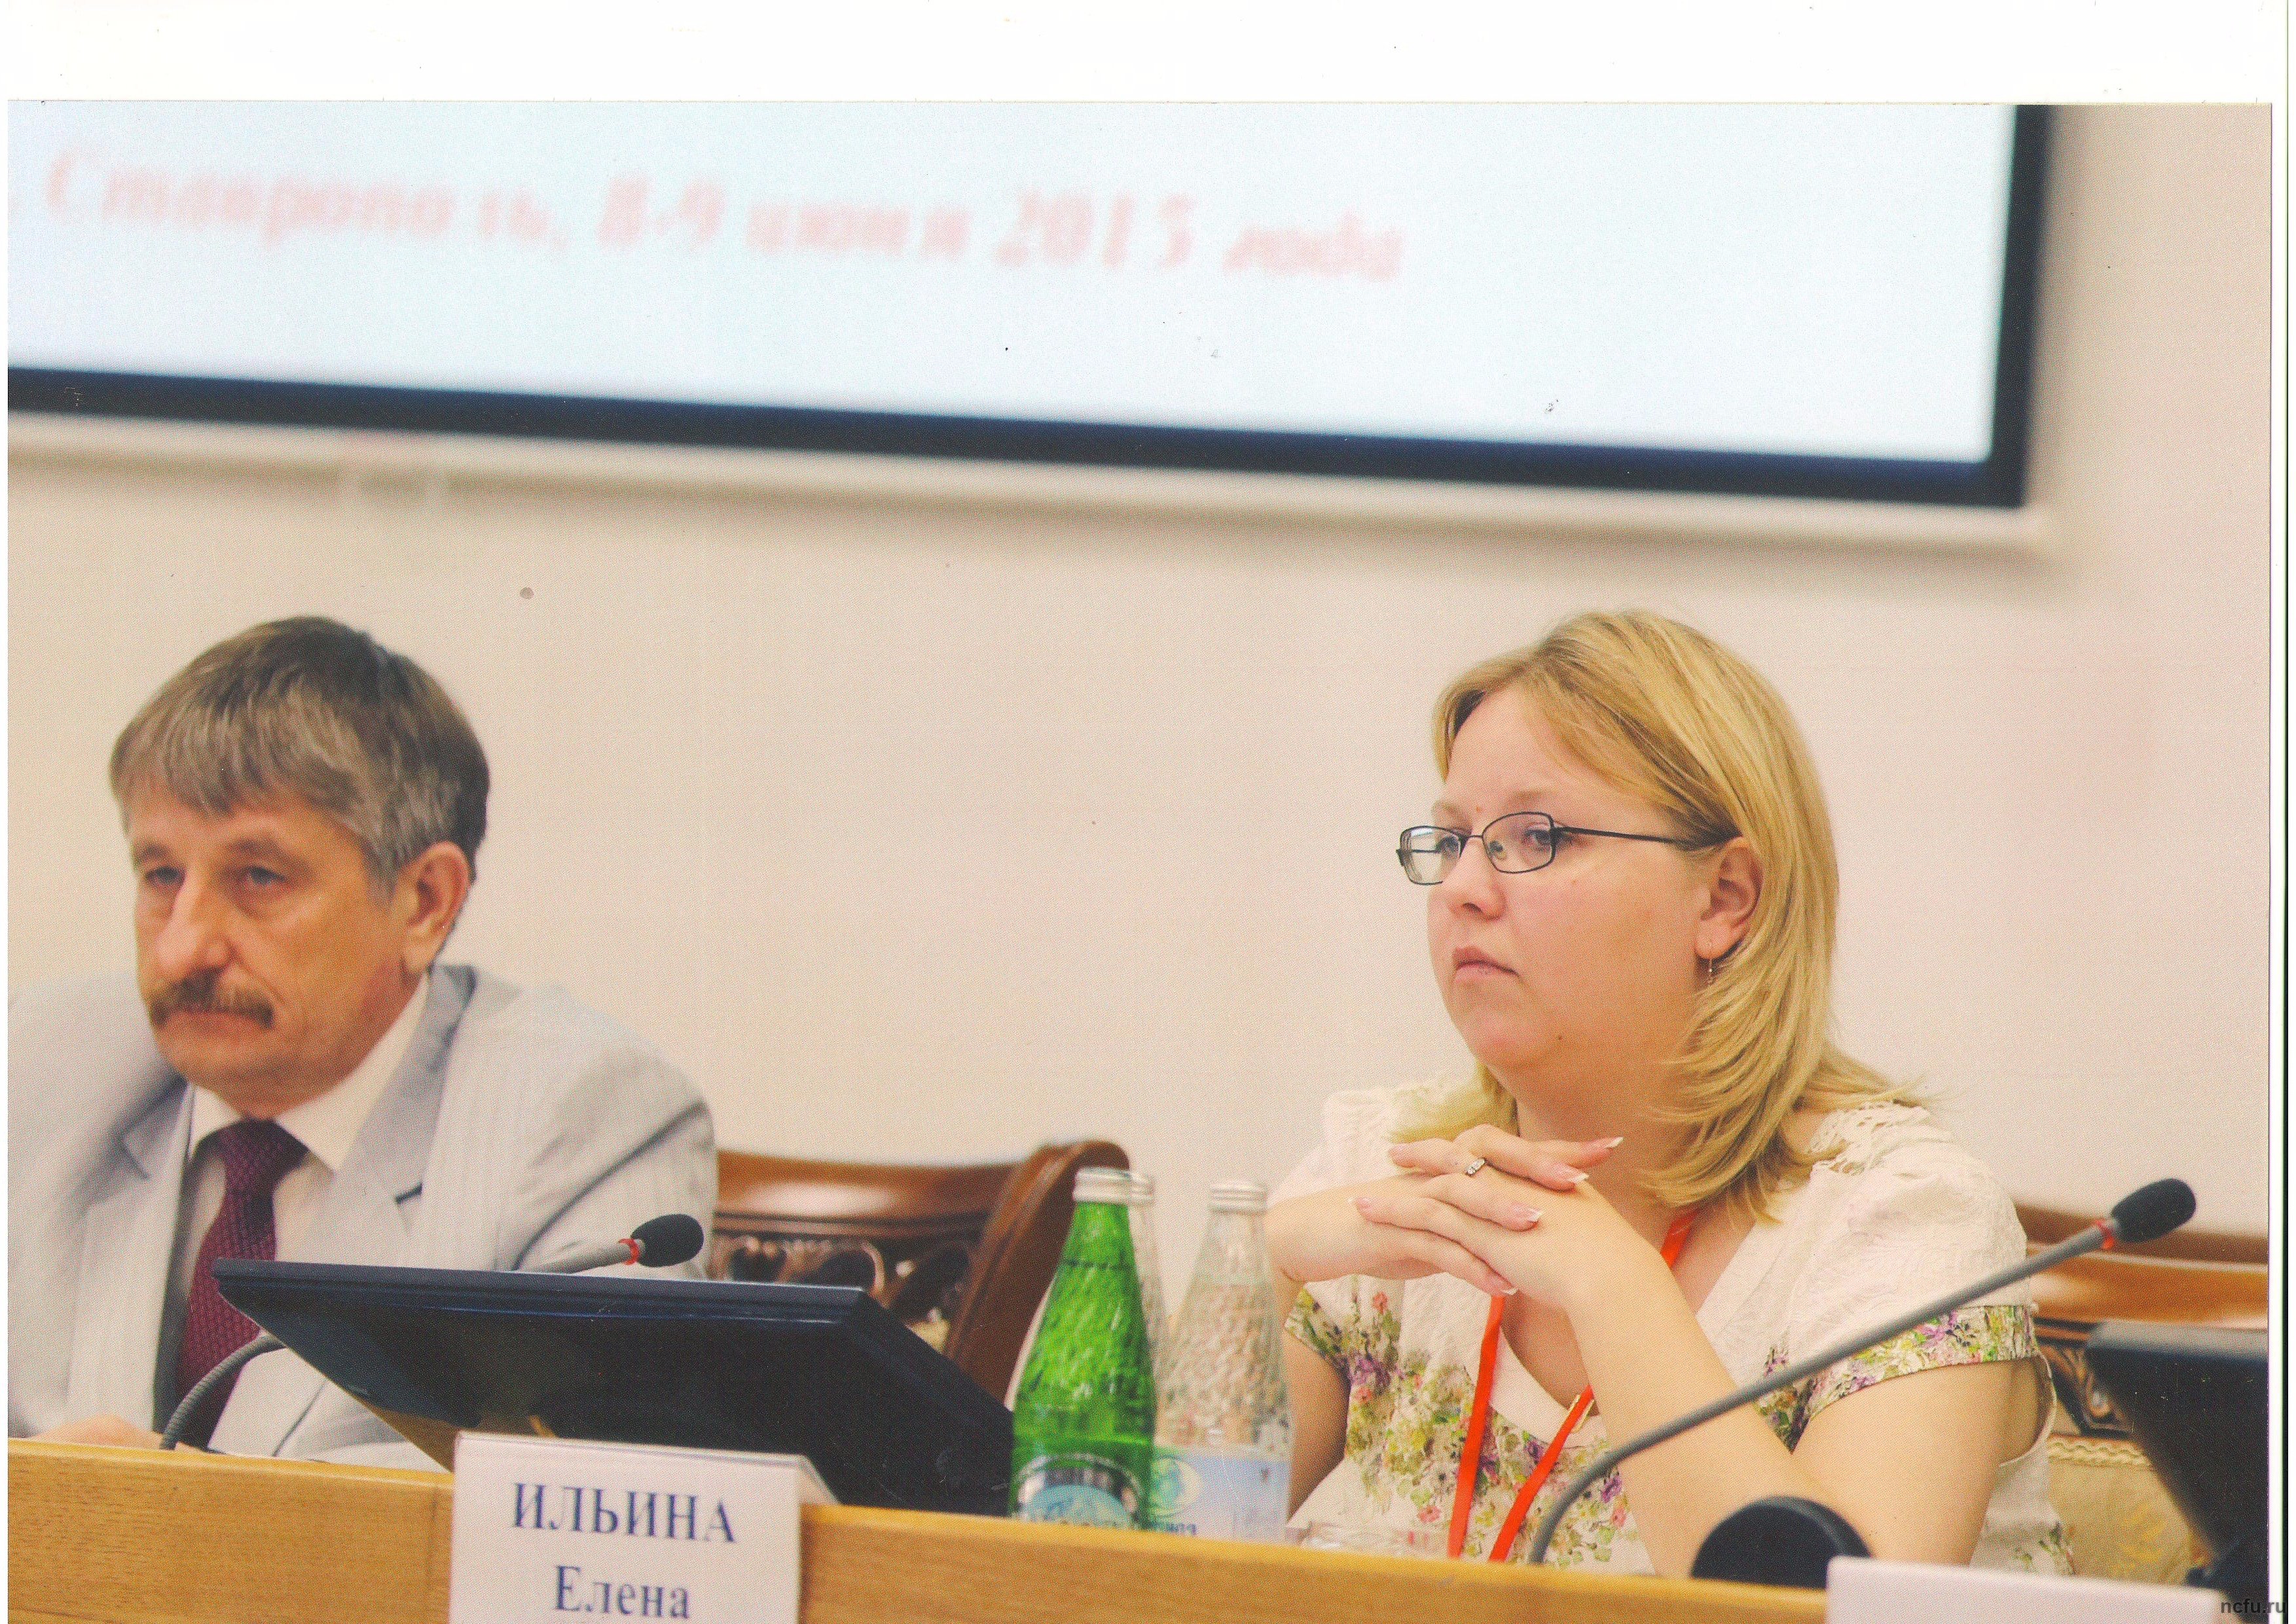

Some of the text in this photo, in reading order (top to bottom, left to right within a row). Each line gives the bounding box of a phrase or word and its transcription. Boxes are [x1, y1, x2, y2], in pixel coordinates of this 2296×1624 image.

[993, 187, 1197, 272] 2015
[512, 1481, 737, 1544] ИЛЬИНА
[554, 1564, 690, 1619] Елена
